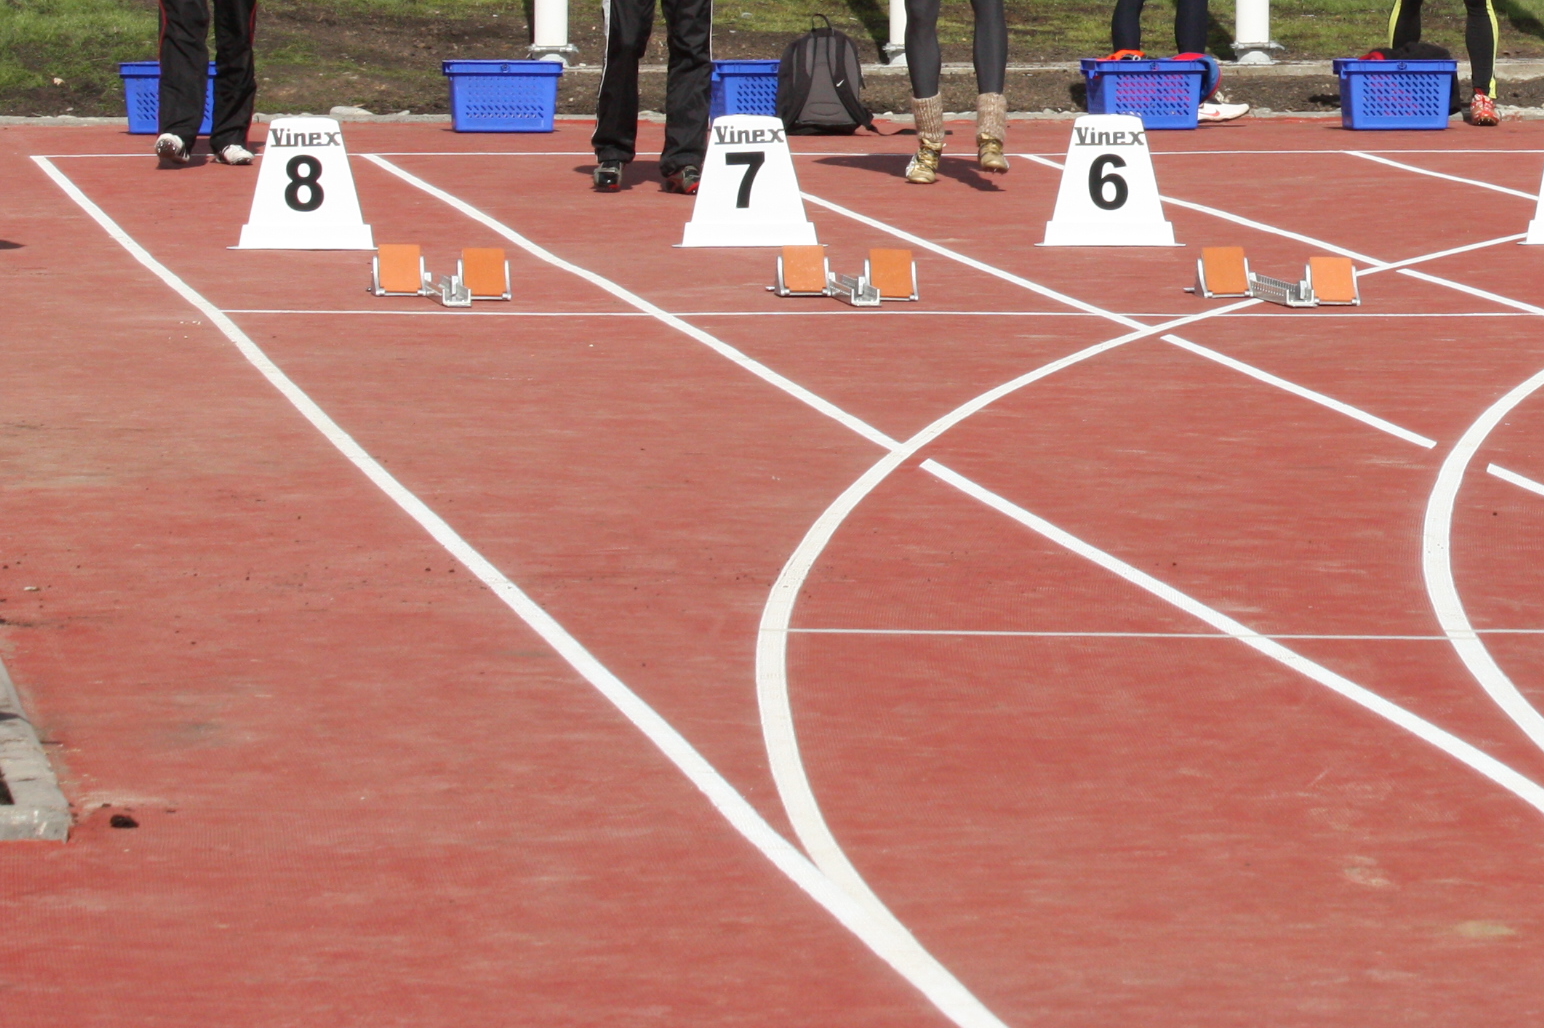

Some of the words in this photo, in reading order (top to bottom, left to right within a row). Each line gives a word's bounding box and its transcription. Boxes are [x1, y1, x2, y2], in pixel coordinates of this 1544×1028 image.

[269, 128, 341, 147] Vinex
[713, 126, 785, 145] Vinex
[1074, 126, 1145, 146] Vinex
[284, 154, 324, 212] 8
[725, 151, 765, 209] 7
[1088, 153, 1129, 211] 6
